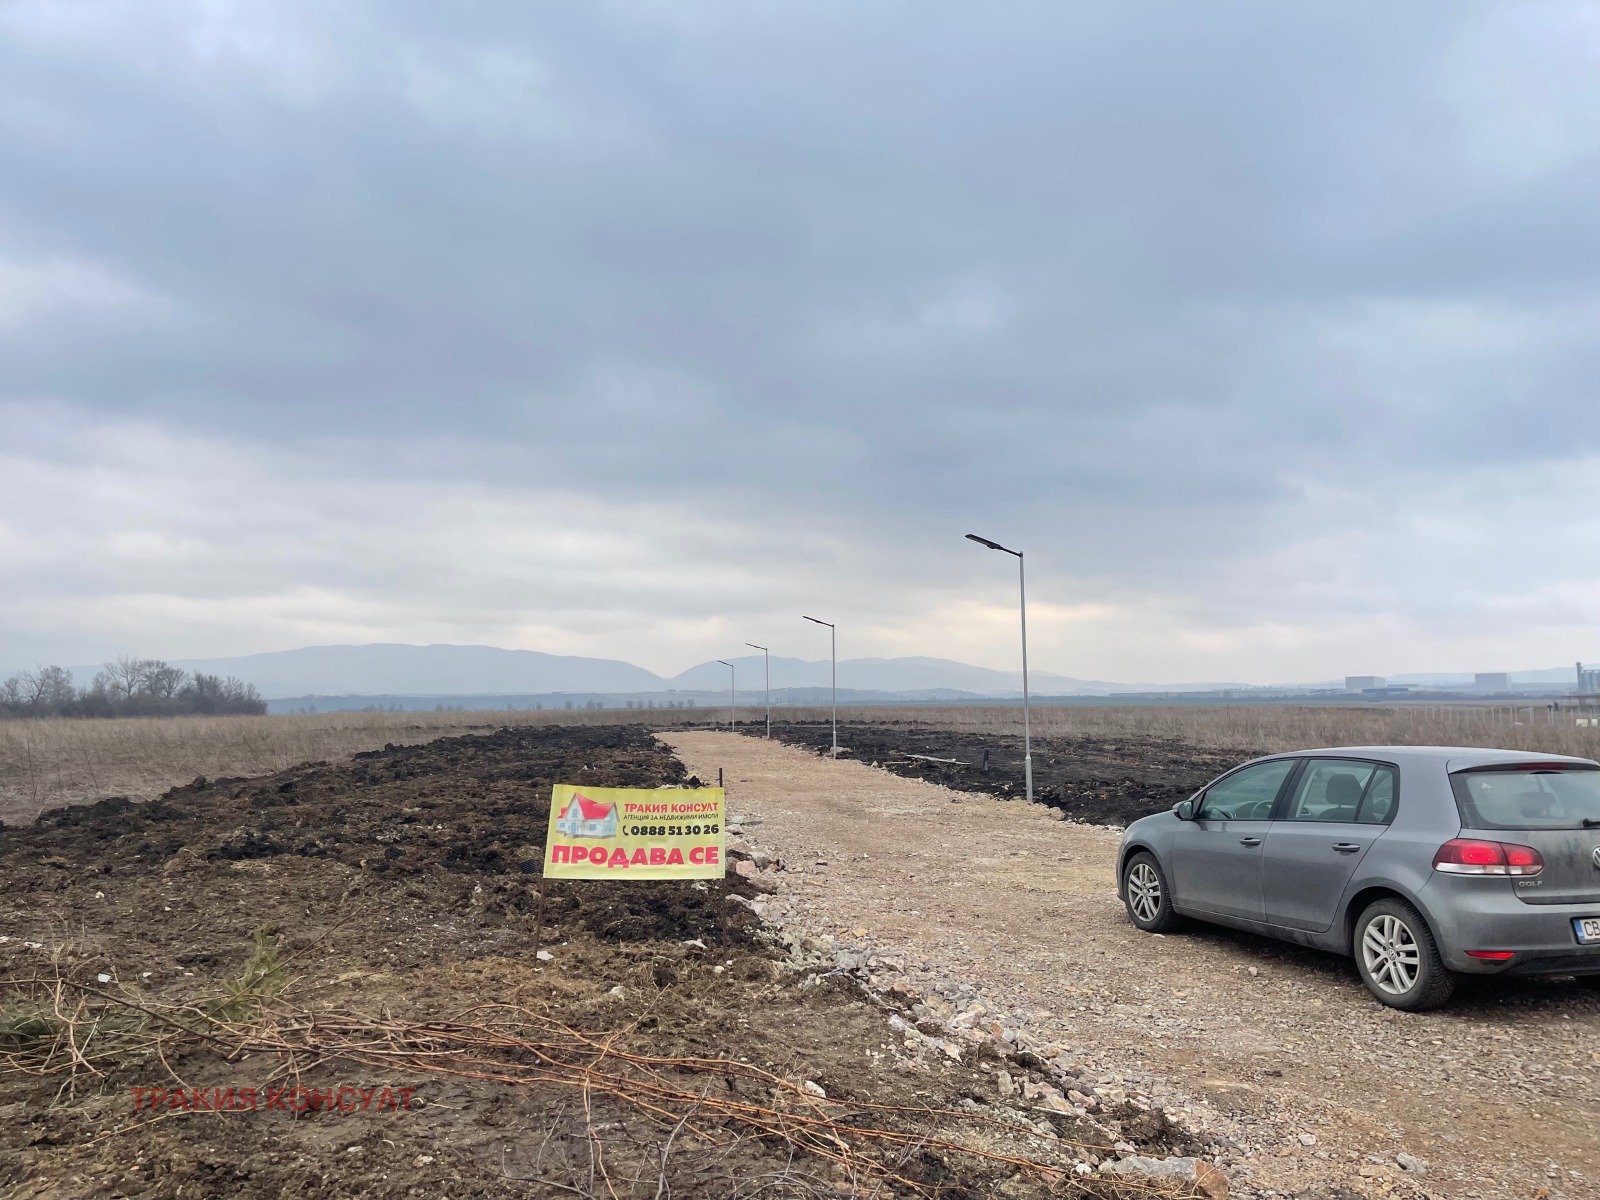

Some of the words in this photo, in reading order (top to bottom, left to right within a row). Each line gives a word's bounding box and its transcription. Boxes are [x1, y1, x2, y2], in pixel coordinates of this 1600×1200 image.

[624, 803, 668, 813] ТРАКИЯ
[671, 802, 719, 813] КОНСУЛТ
[630, 826, 666, 836] 0888
[668, 826, 683, 836] 51
[684, 825, 700, 836] 30
[703, 824, 720, 835] 26
[551, 845, 685, 869] ПРОДАВА
[688, 846, 719, 865] СЕ
